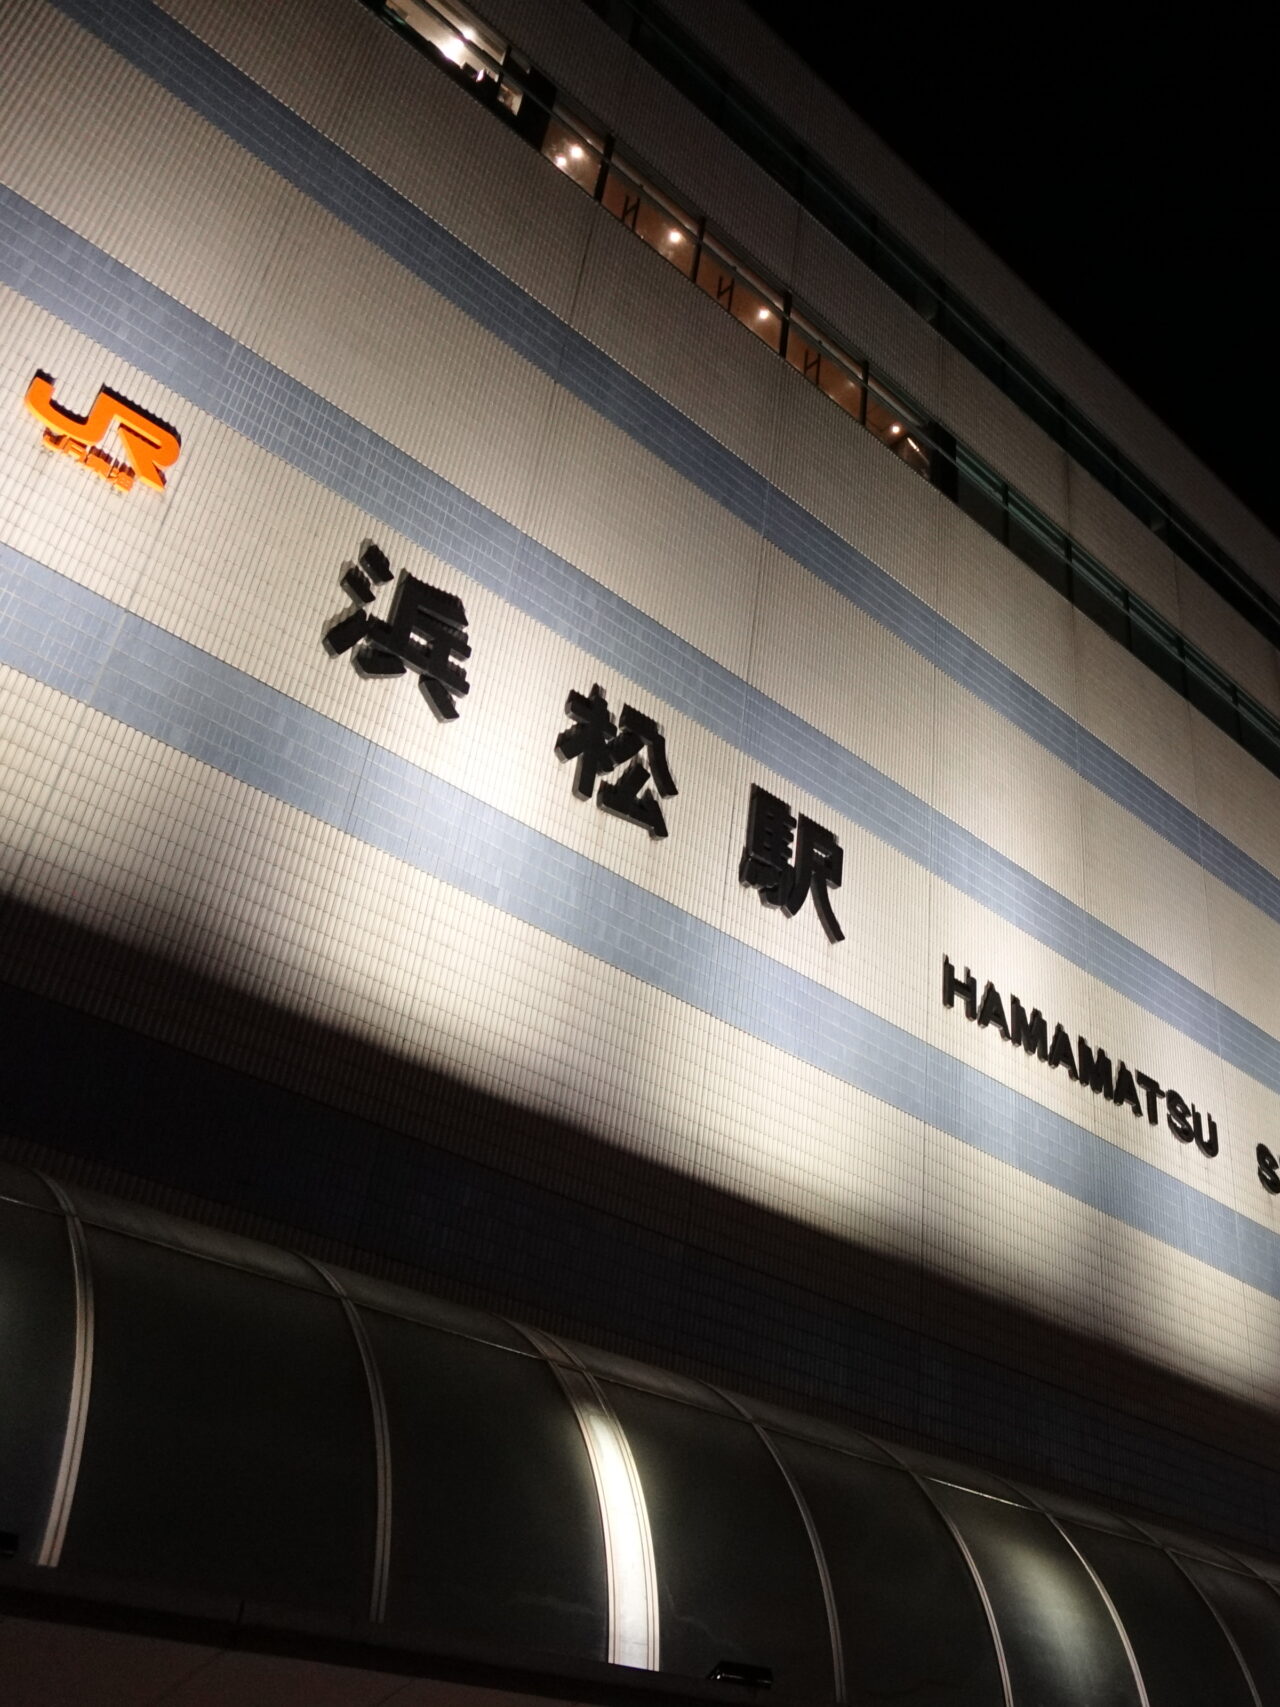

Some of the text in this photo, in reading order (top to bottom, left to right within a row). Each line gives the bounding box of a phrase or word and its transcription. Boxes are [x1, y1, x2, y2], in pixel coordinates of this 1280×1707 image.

[24, 368, 182, 492] JR
[321, 537, 846, 944] 浜松駅
[942, 953, 1219, 1158] HAMAMATSU
